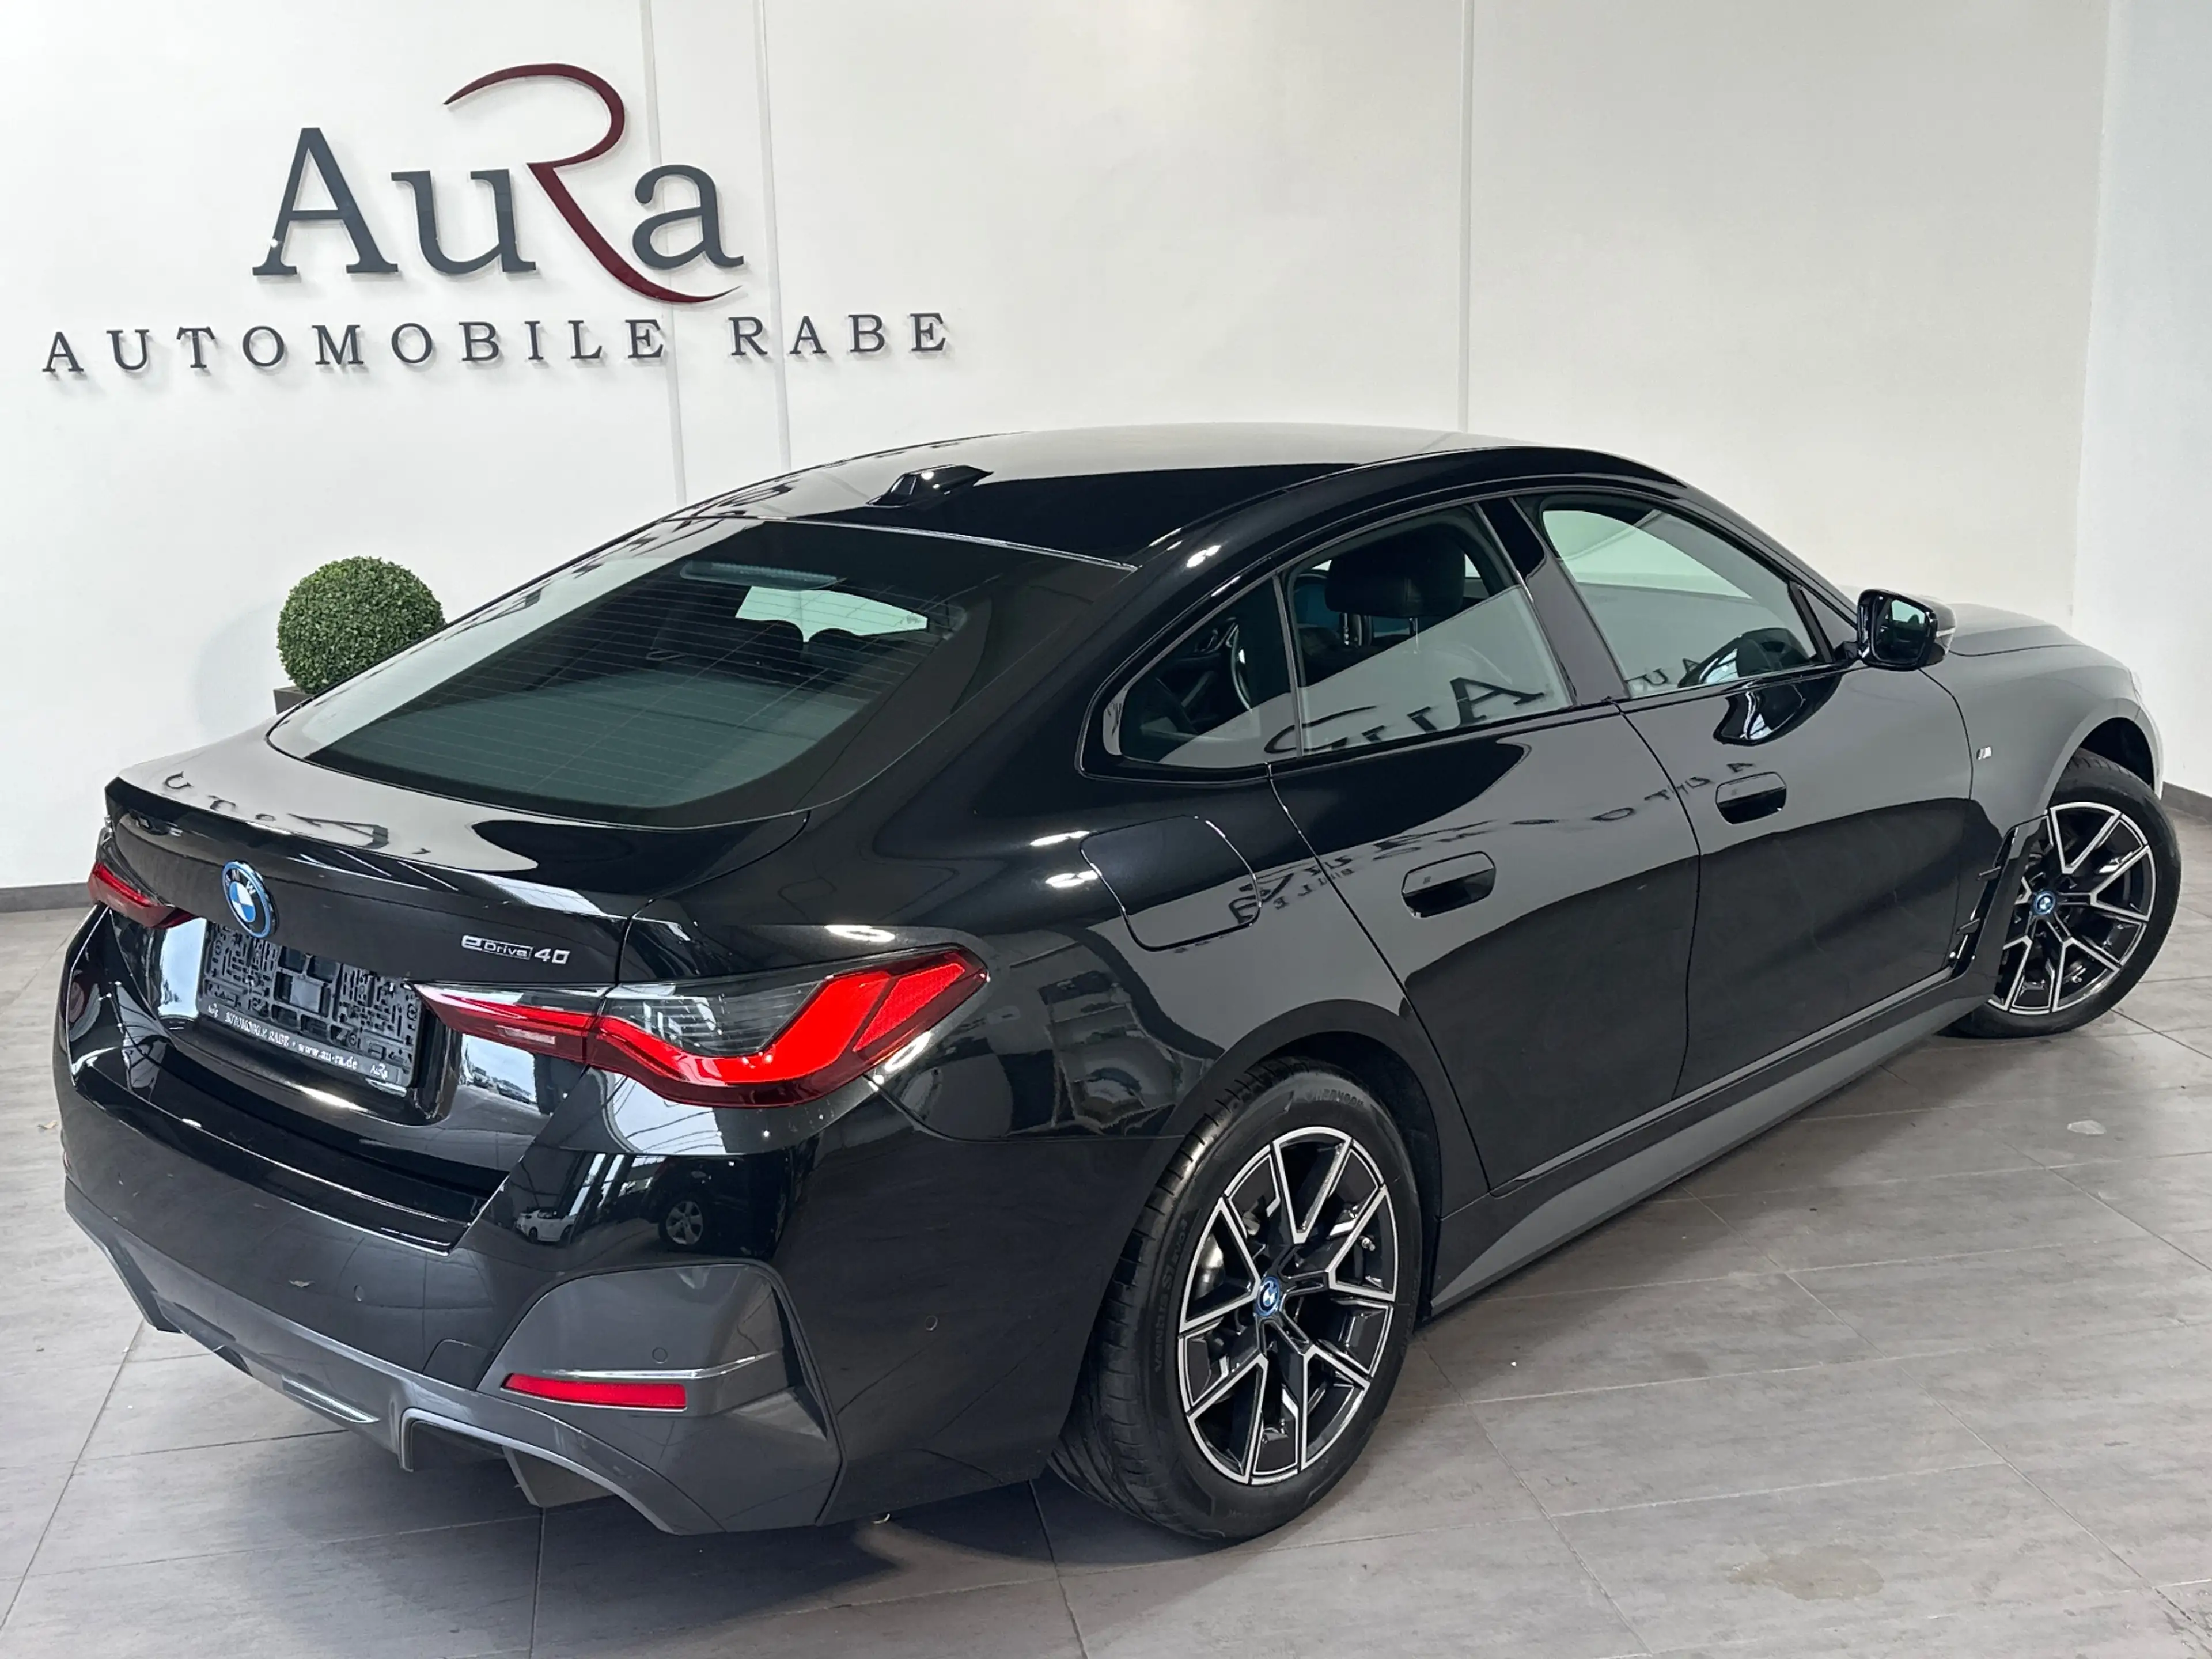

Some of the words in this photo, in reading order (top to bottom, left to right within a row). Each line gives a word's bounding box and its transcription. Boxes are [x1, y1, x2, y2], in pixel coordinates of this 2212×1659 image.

[252, 63, 744, 305] AuRa
[42, 319, 664, 374] AUTOMOBILE
[728, 313, 946, 356] RABE
[533, 948, 570, 965] 40
